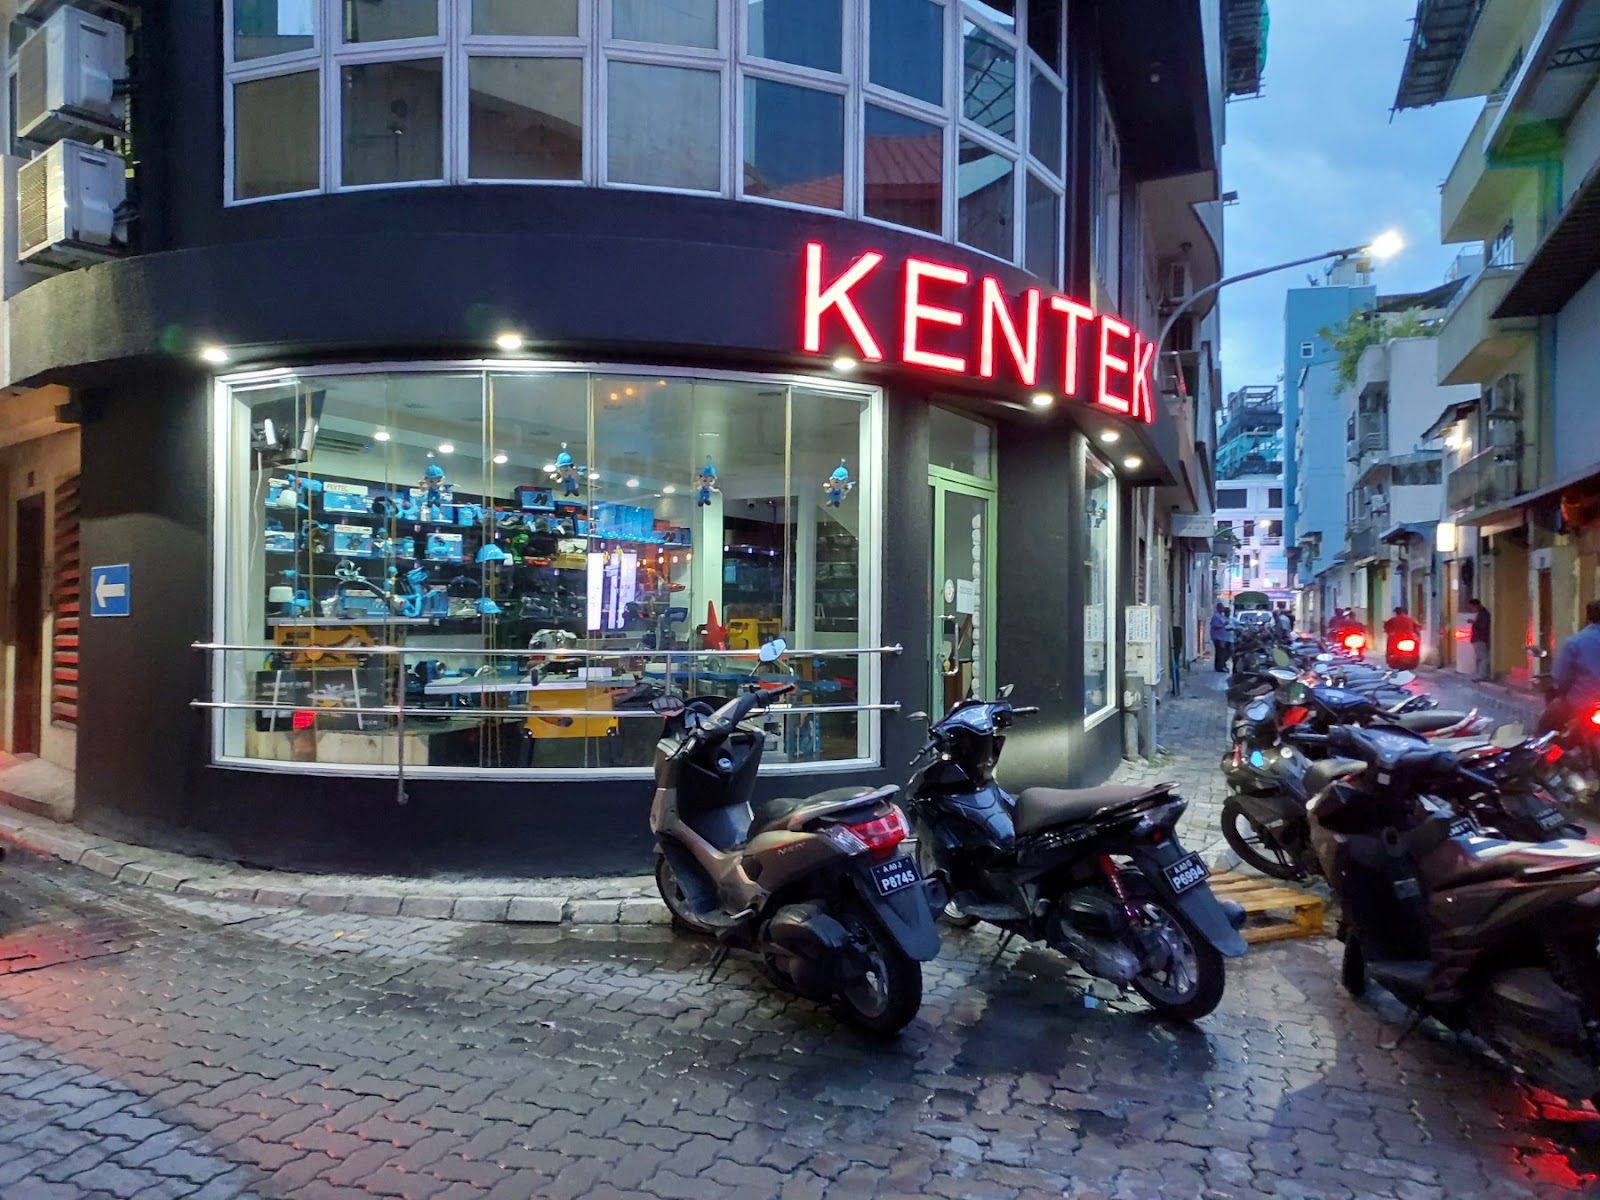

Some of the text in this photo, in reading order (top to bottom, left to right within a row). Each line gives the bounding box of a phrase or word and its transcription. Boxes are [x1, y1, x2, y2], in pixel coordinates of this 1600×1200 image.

[802, 241, 1155, 425] KENTEK
[881, 870, 915, 891] P8745
[1172, 864, 1205, 889] P6994
